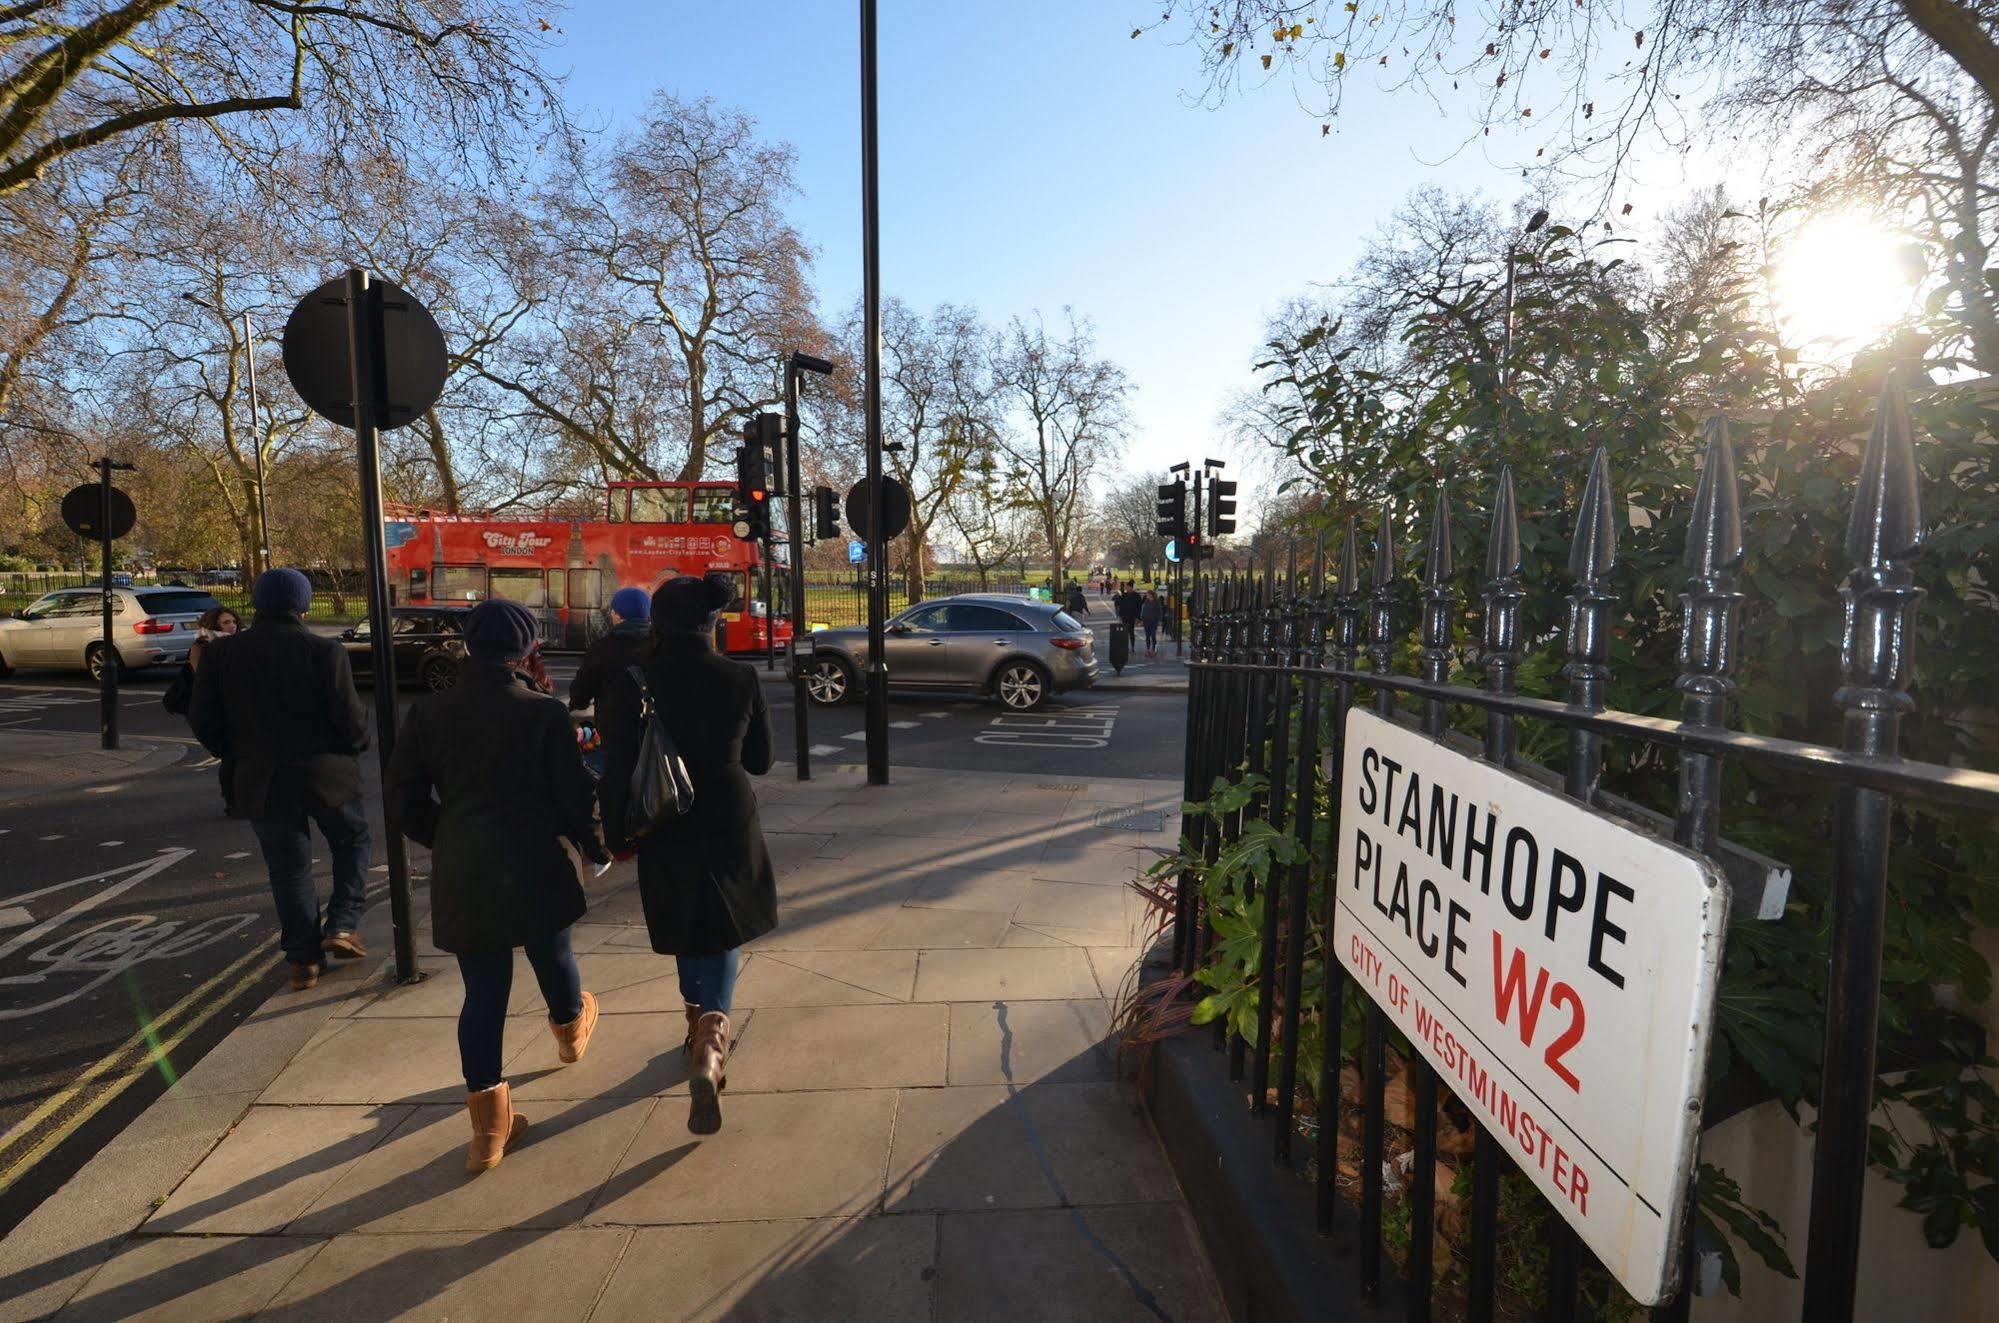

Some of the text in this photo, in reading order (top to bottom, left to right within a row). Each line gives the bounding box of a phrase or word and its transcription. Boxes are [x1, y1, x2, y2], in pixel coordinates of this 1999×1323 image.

[483, 531, 552, 549] City Tour
[502, 546, 535, 556] LONDON
[1354, 828, 1587, 1095] PLACE W2
[1359, 746, 1635, 990] STANHOPE
[1351, 933, 1590, 1217] CITY OF WESTMINSTER
